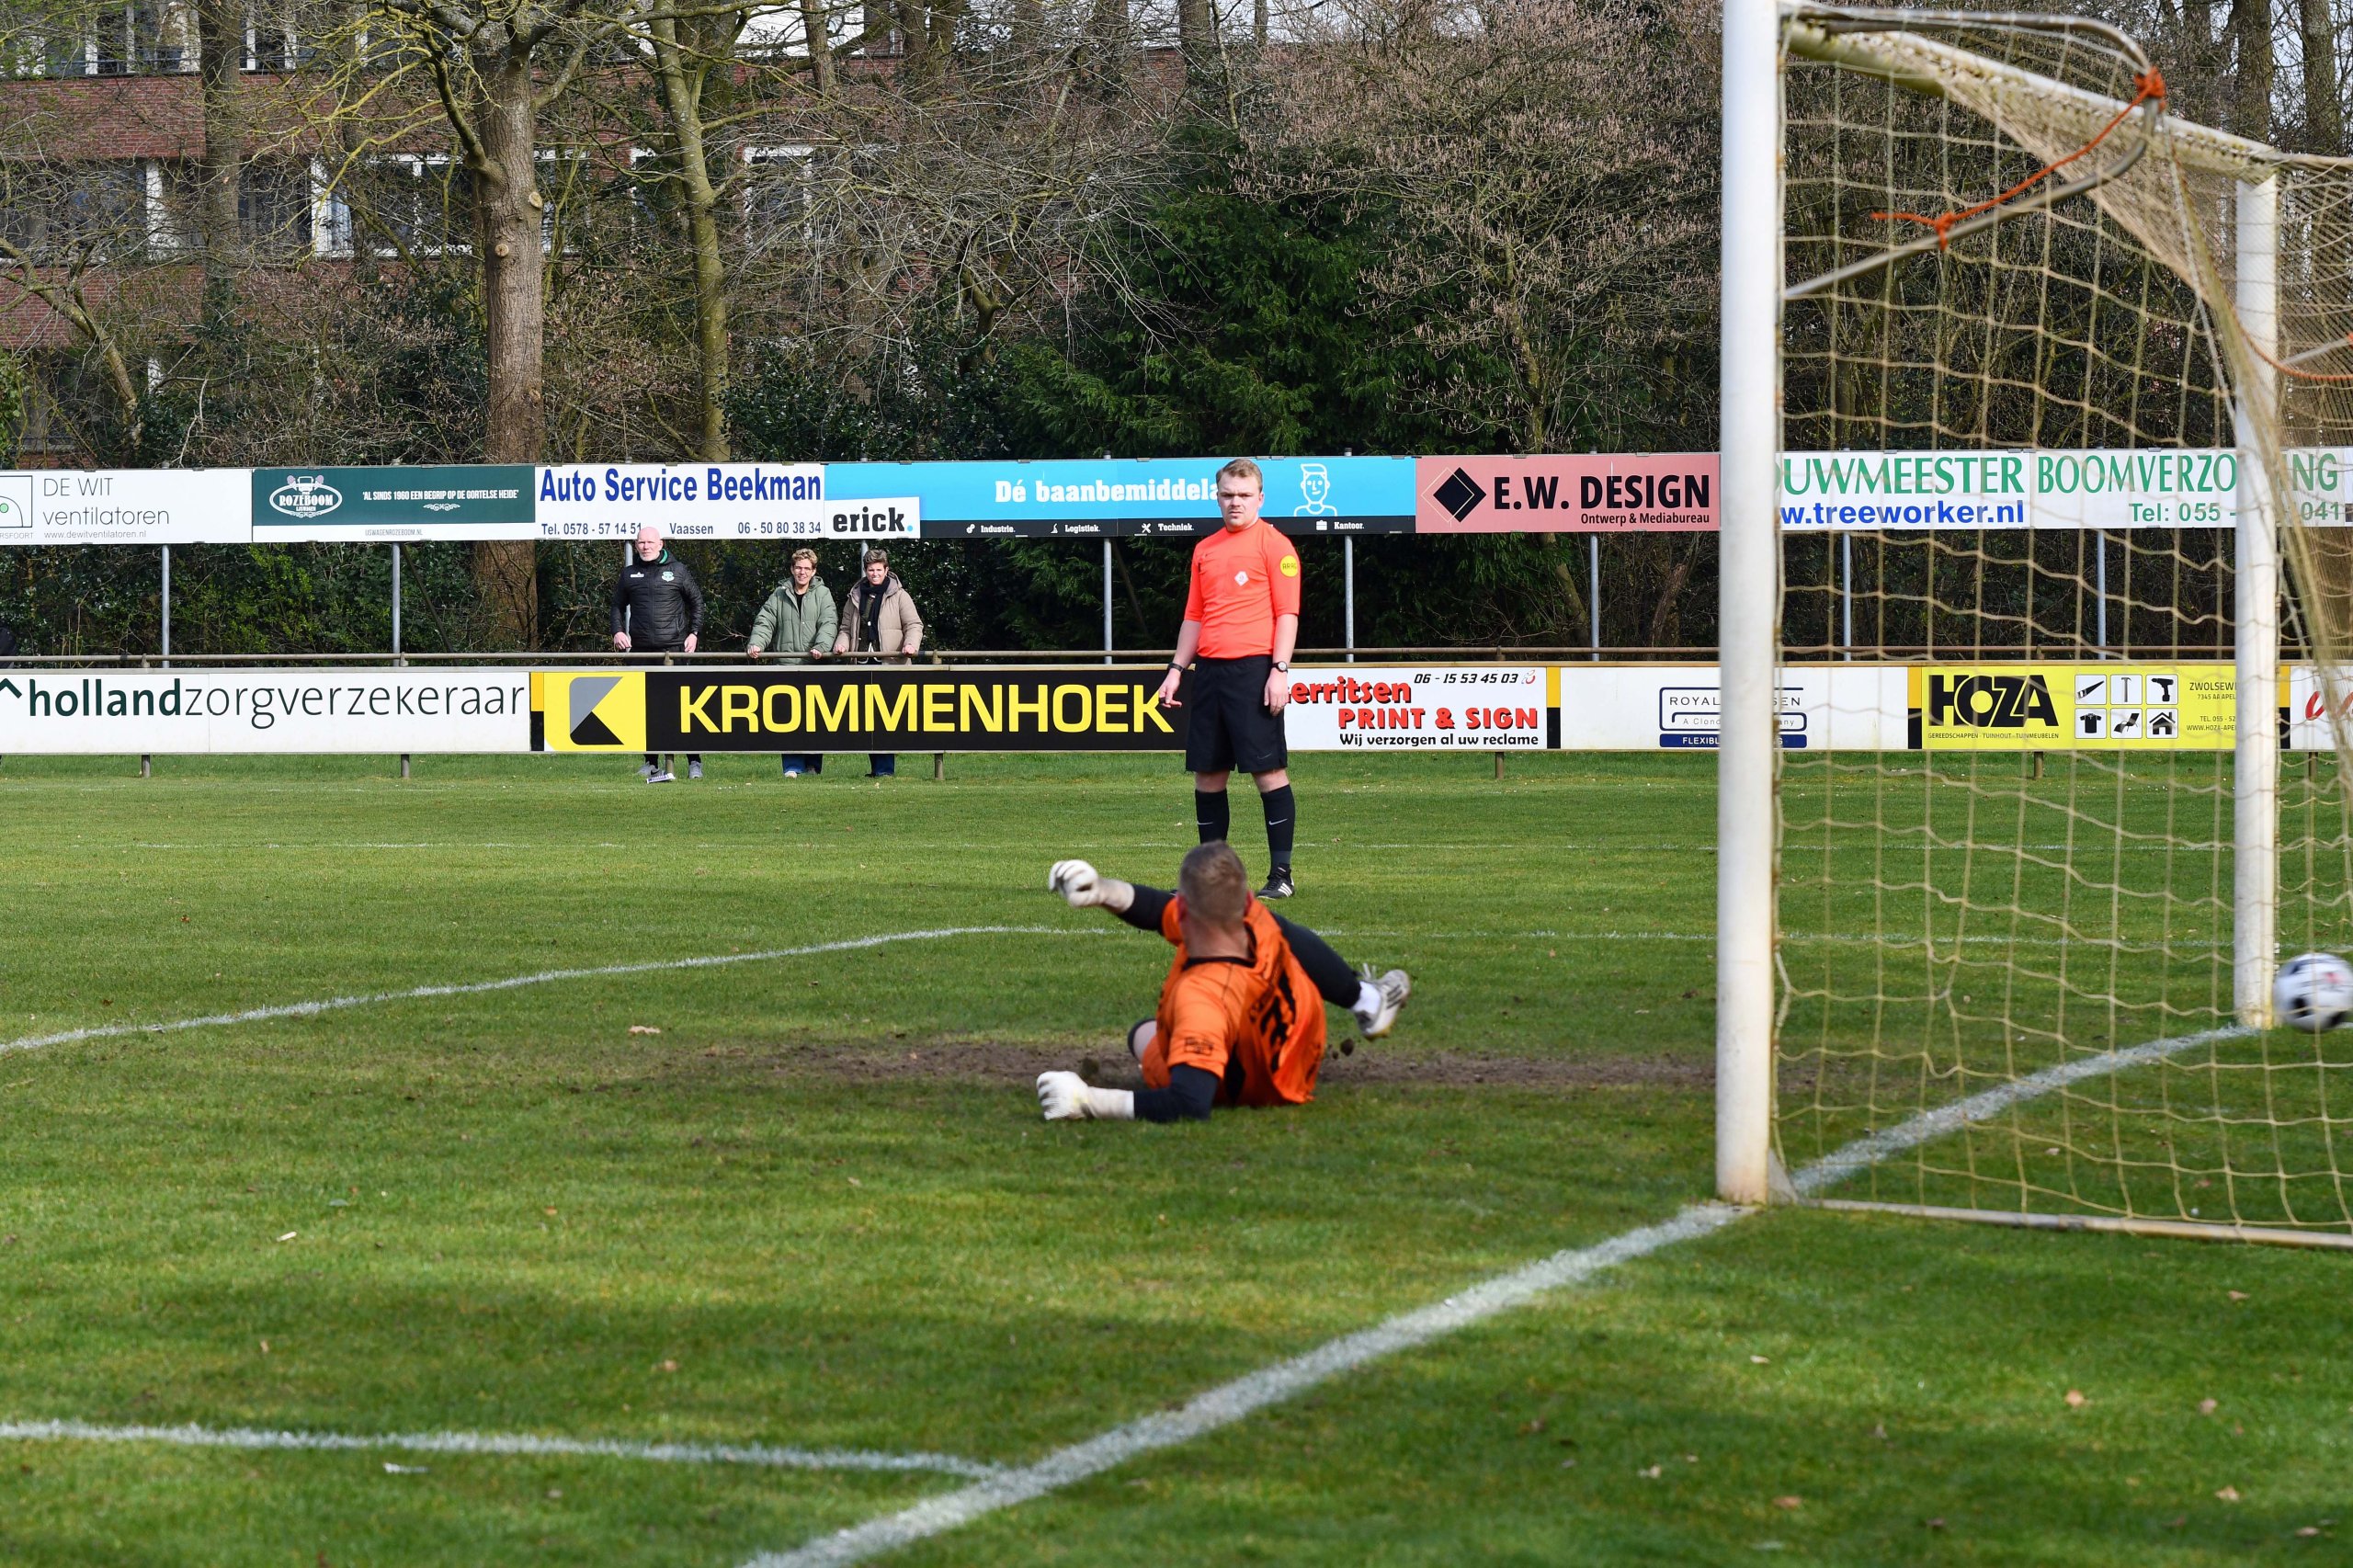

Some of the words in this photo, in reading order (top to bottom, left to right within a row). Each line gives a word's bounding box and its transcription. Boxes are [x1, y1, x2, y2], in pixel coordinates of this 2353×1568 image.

[540, 469, 596, 502] Auto
[605, 468, 698, 502] Service
[707, 467, 821, 501] Beekman
[1776, 456, 2025, 495] UWMEESTER
[43, 478, 70, 496] DE
[78, 477, 113, 496] WIT
[373, 491, 392, 501] SINDS
[393, 491, 409, 500] 1960
[410, 491, 423, 500] EEN
[424, 490, 447, 500] BEGRIP
[448, 490, 456, 500] OP
[457, 490, 465, 500] DE
[466, 490, 497, 499] GORTELSE
[995, 479, 1026, 502] Dé
[1036, 478, 1218, 503] baanbemiddela
[1494, 476, 1570, 510] E.W.
[1581, 474, 1710, 508] DESIGN
[279, 494, 334, 506] ROZEBOOM
[43, 506, 169, 525] ventilatoren
[833, 506, 913, 532] erick.
[1581, 513, 1627, 527] Ontwerp
[1630, 513, 1636, 523] &
[1640, 512, 1710, 524] Mediabureau
[1779, 500, 2024, 525] w.treeworker.nl
[2129, 503, 2169, 522] Tel:
[2178, 503, 2221, 522] 055
[44, 530, 147, 539] www.dewitventilatoren.nl
[541, 523, 560, 535] Tel.
[563, 523, 589, 535] 0578
[598, 523, 611, 534] 57
[615, 523, 627, 534] 14
[630, 522, 642, 534] 51
[669, 522, 713, 534] Vaassen
[738, 522, 750, 534] 06
[760, 522, 773, 534] 50
[777, 522, 790, 534] 80
[792, 522, 805, 533] 38
[808, 521, 822, 533] 34
[1065, 525, 1100, 533] Logistiek.
[1158, 523, 1194, 531] Techniek.
[1334, 521, 1364, 529] Kantoor.
[1288, 676, 1412, 704] erritsen
[1414, 674, 1432, 684] 06
[1443, 674, 1457, 684] 15
[1461, 674, 1477, 684] 53
[1481, 674, 1498, 684] 45
[1501, 674, 1518, 684] 03
[2189, 682, 2236, 690] ZWOLSEW
[29, 678, 524, 730] hollandzorgverzekeraar
[680, 684, 1174, 733] KROMMENHOEK
[1669, 697, 1721, 706] ROYAL
[1928, 675, 2059, 727] HOZA
[1338, 708, 1426, 730] PRINT
[1435, 708, 1455, 729] &
[1466, 708, 1538, 730] SIGN
[1340, 733, 1363, 746] Wij
[1368, 736, 1436, 746] verzorgen
[1440, 733, 1453, 745] al
[1458, 737, 1479, 745] uw
[1483, 733, 1539, 745] reclame
